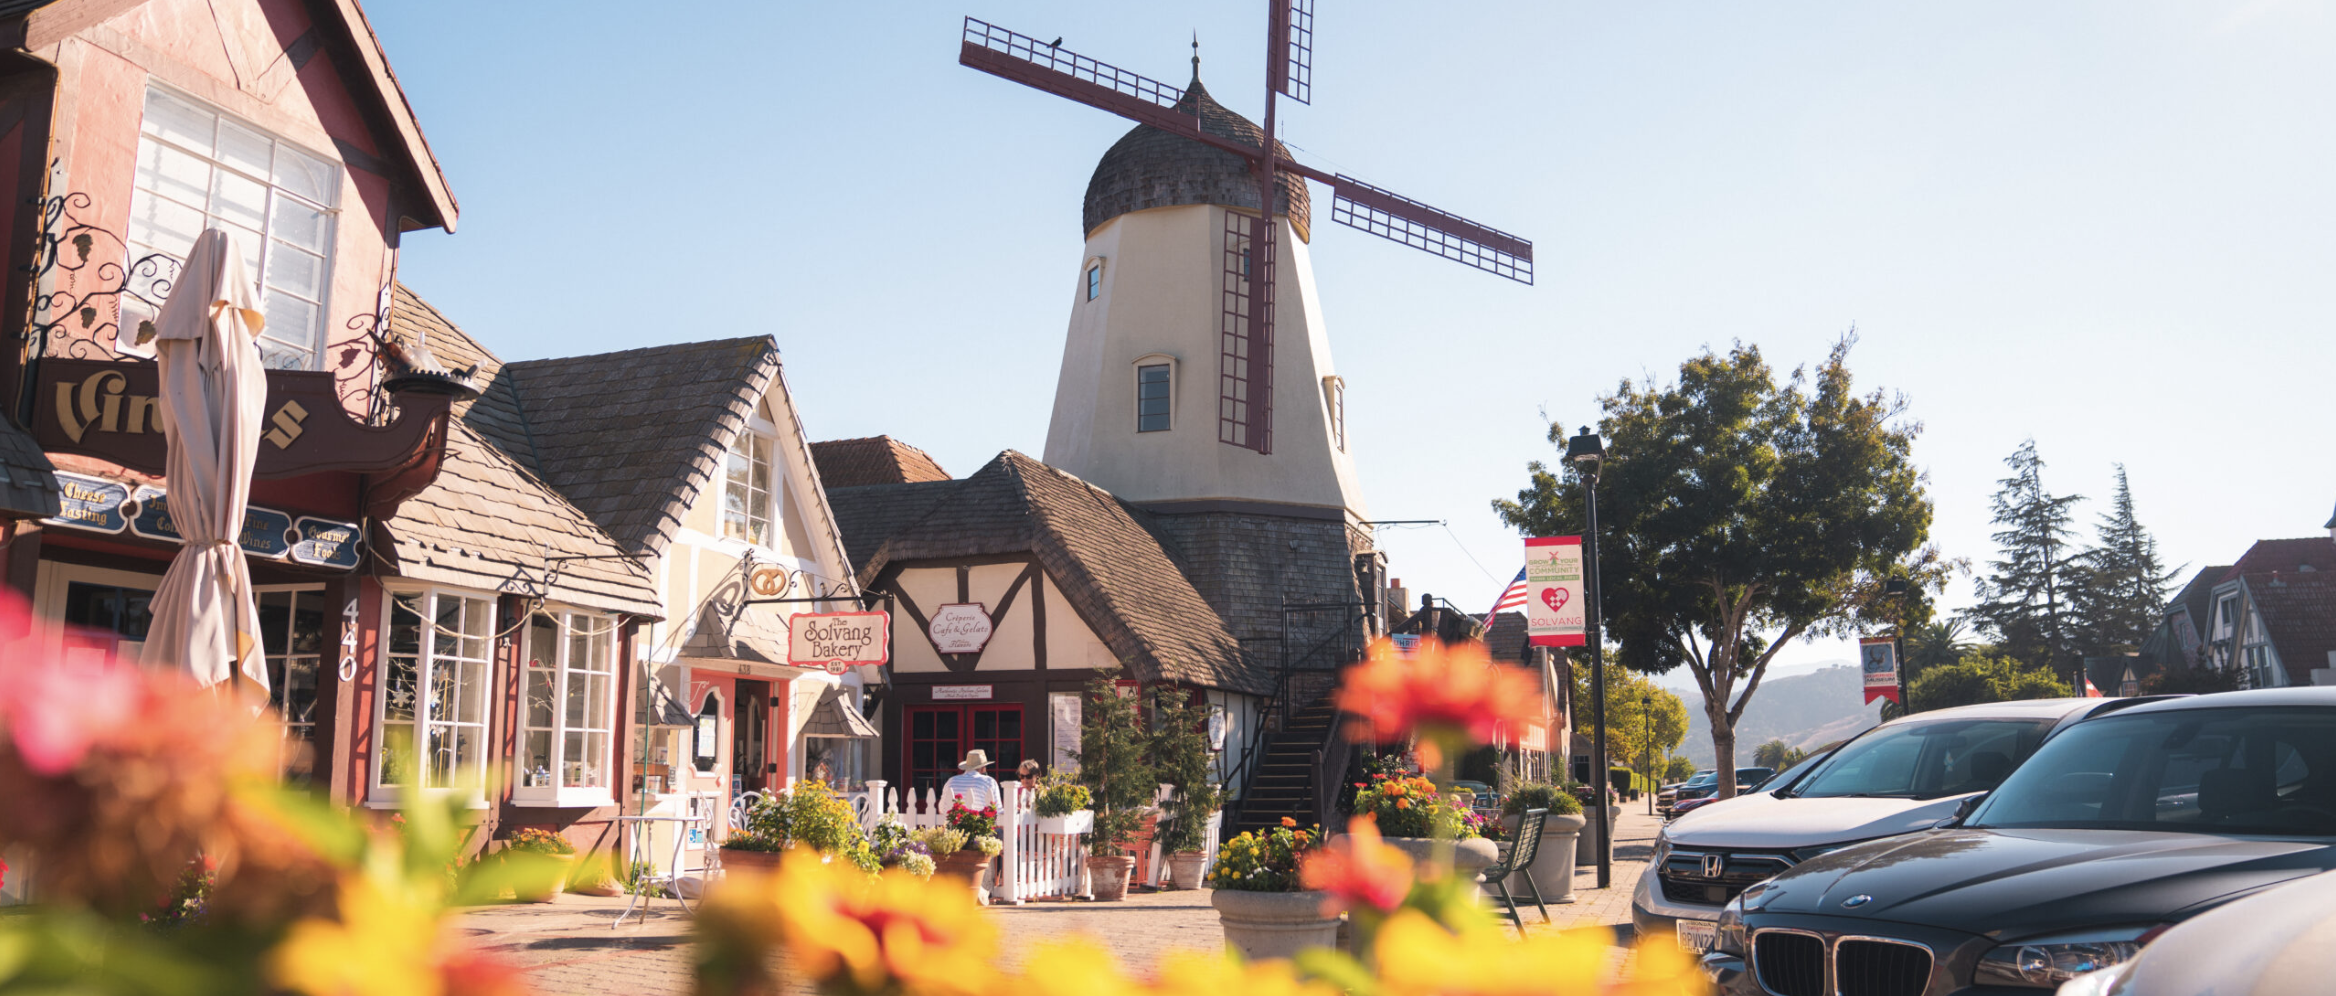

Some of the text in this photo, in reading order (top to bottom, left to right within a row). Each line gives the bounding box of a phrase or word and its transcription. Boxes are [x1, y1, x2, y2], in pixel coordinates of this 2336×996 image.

[63, 481, 106, 504] Cheese
[59, 500, 107, 526] Tasting
[244, 512, 270, 531] Fine
[238, 529, 271, 550] Wines
[307, 525, 351, 544] Gourmet
[311, 541, 342, 560] Foods
[1529, 566, 1580, 575] COMMUNITY
[832, 617, 848, 627] The
[960, 621, 989, 636] Gelato
[1531, 616, 1582, 627] SOLVANG
[338, 597, 360, 682] 440
[804, 620, 872, 646] Solvang
[812, 641, 863, 661] Bakery
